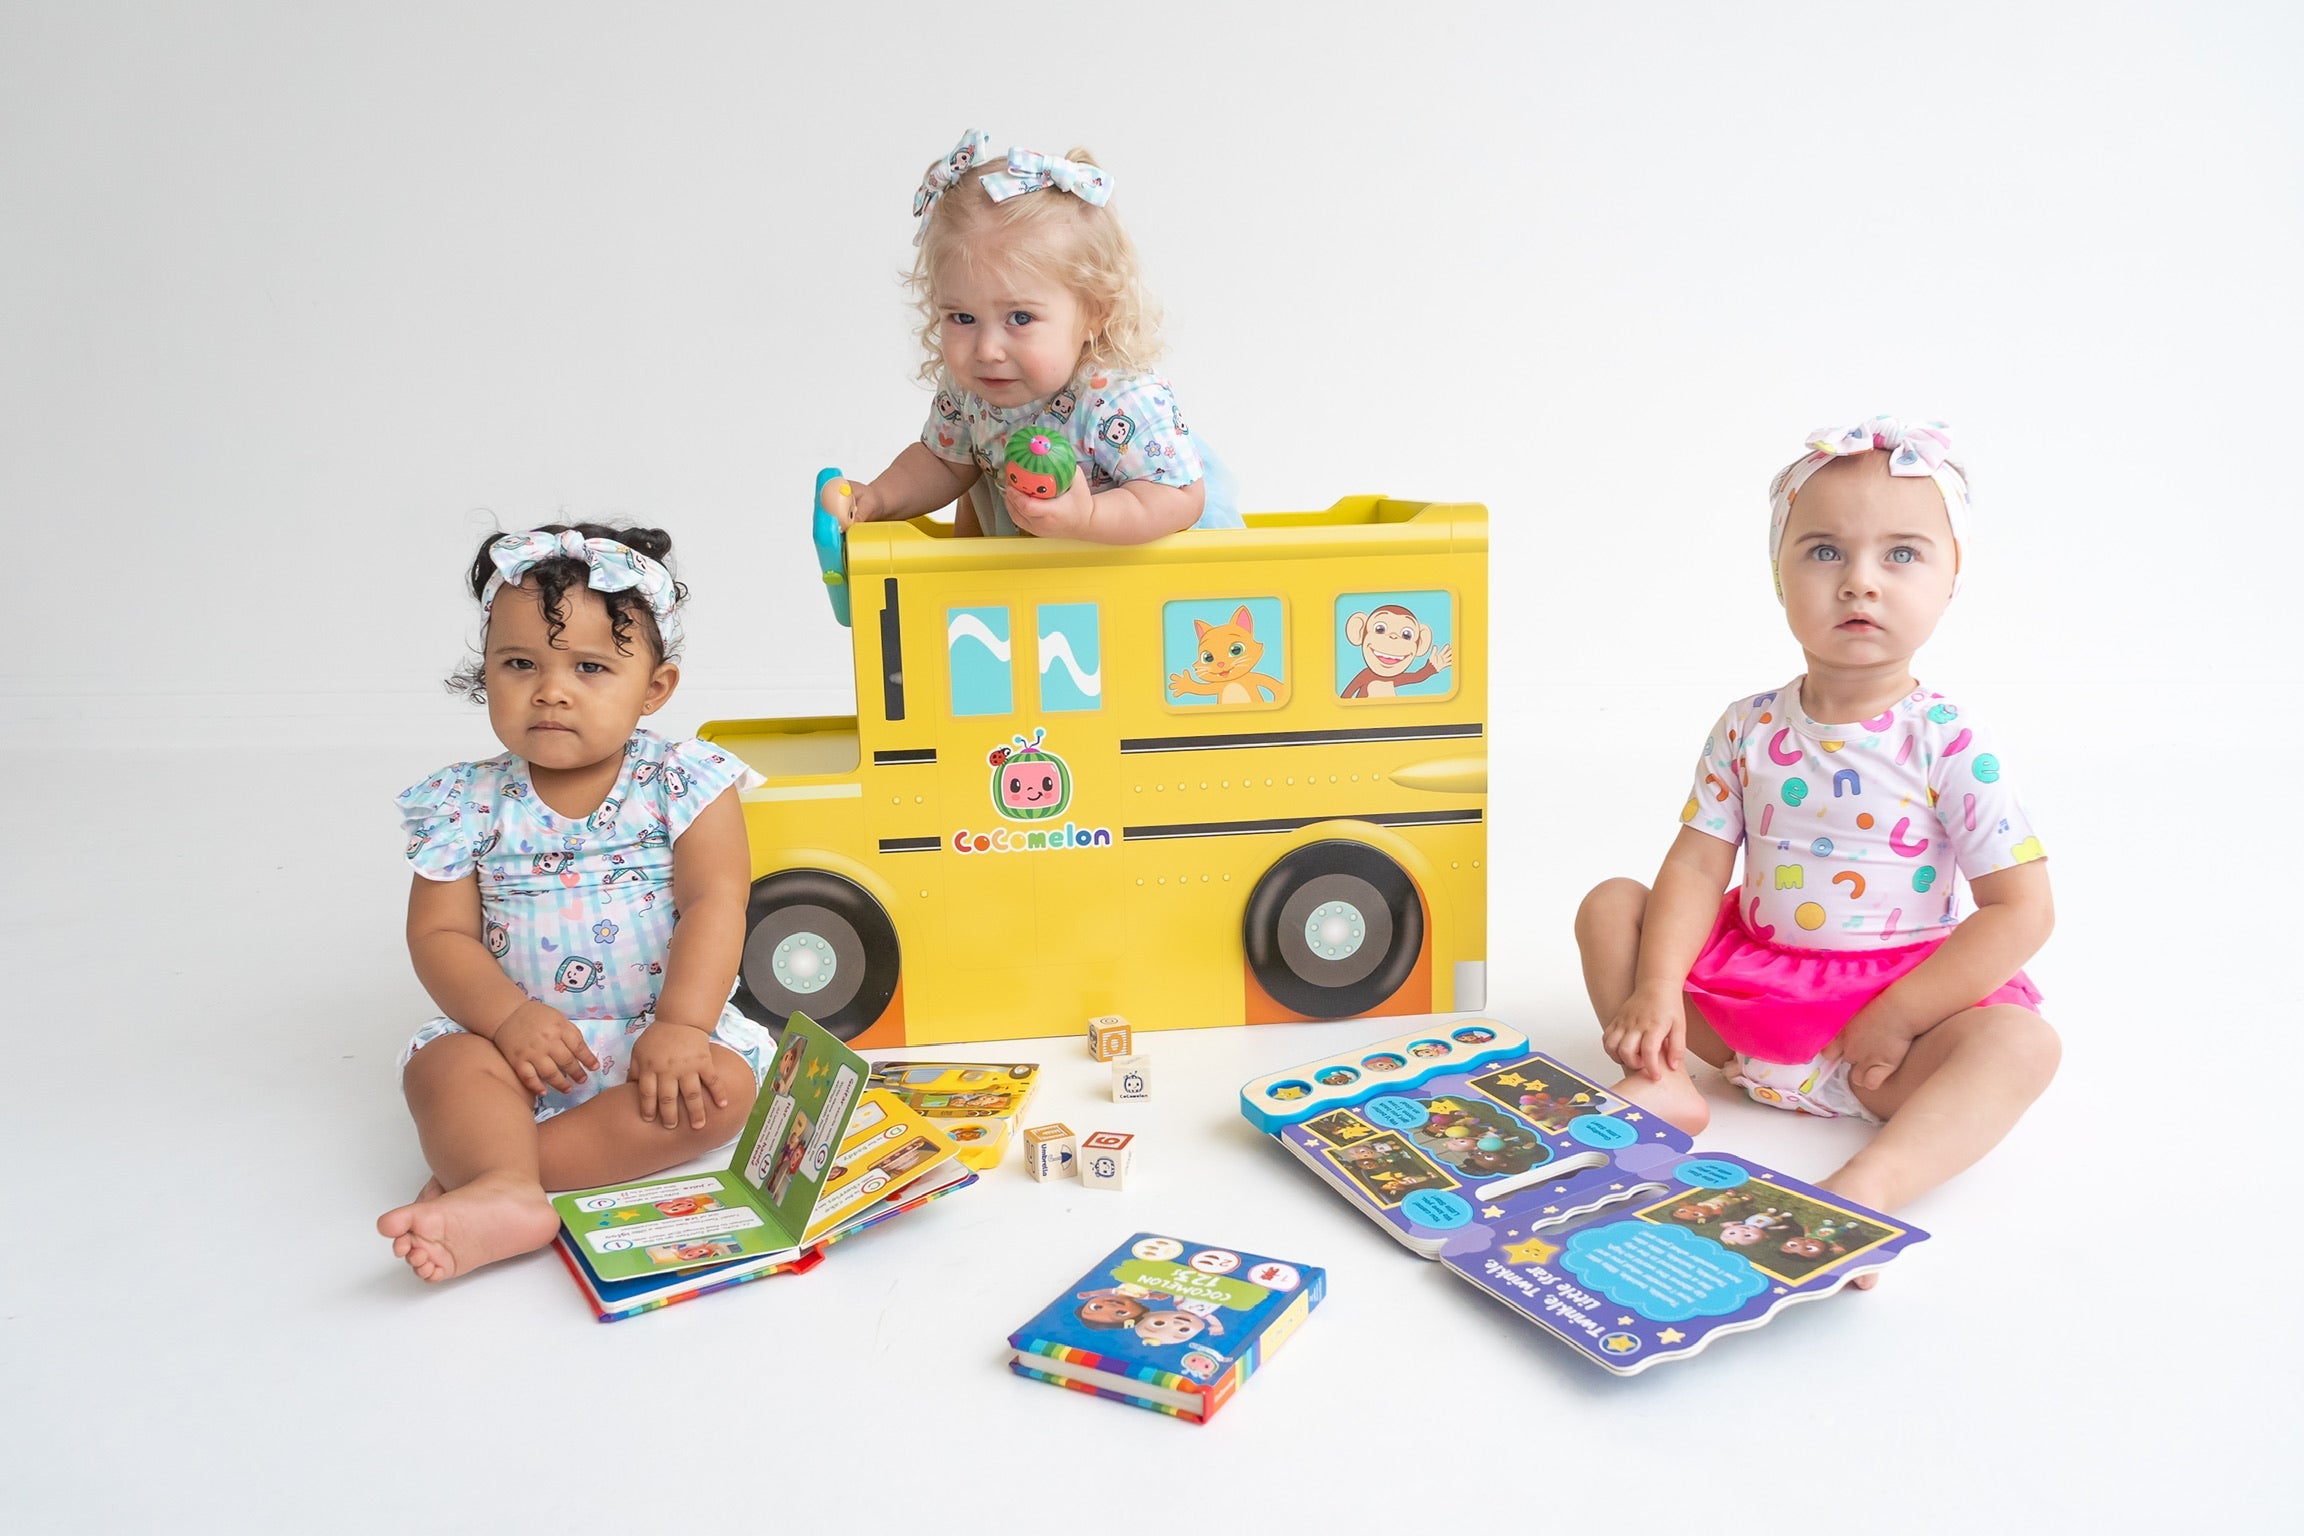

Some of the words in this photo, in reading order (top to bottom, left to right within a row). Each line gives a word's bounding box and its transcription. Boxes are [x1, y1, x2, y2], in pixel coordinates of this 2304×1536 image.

[758, 1159, 773, 1175] H
[814, 1149, 829, 1165] G
[1040, 1143, 1048, 1176] Umbrella
[1137, 1274, 1232, 1302] COCOMELON
[1484, 1258, 1541, 1298] Twinkle,
[1525, 1266, 1562, 1285] Star
[1556, 1283, 1601, 1311] Little
[1544, 1294, 1606, 1338] Twinkle,
